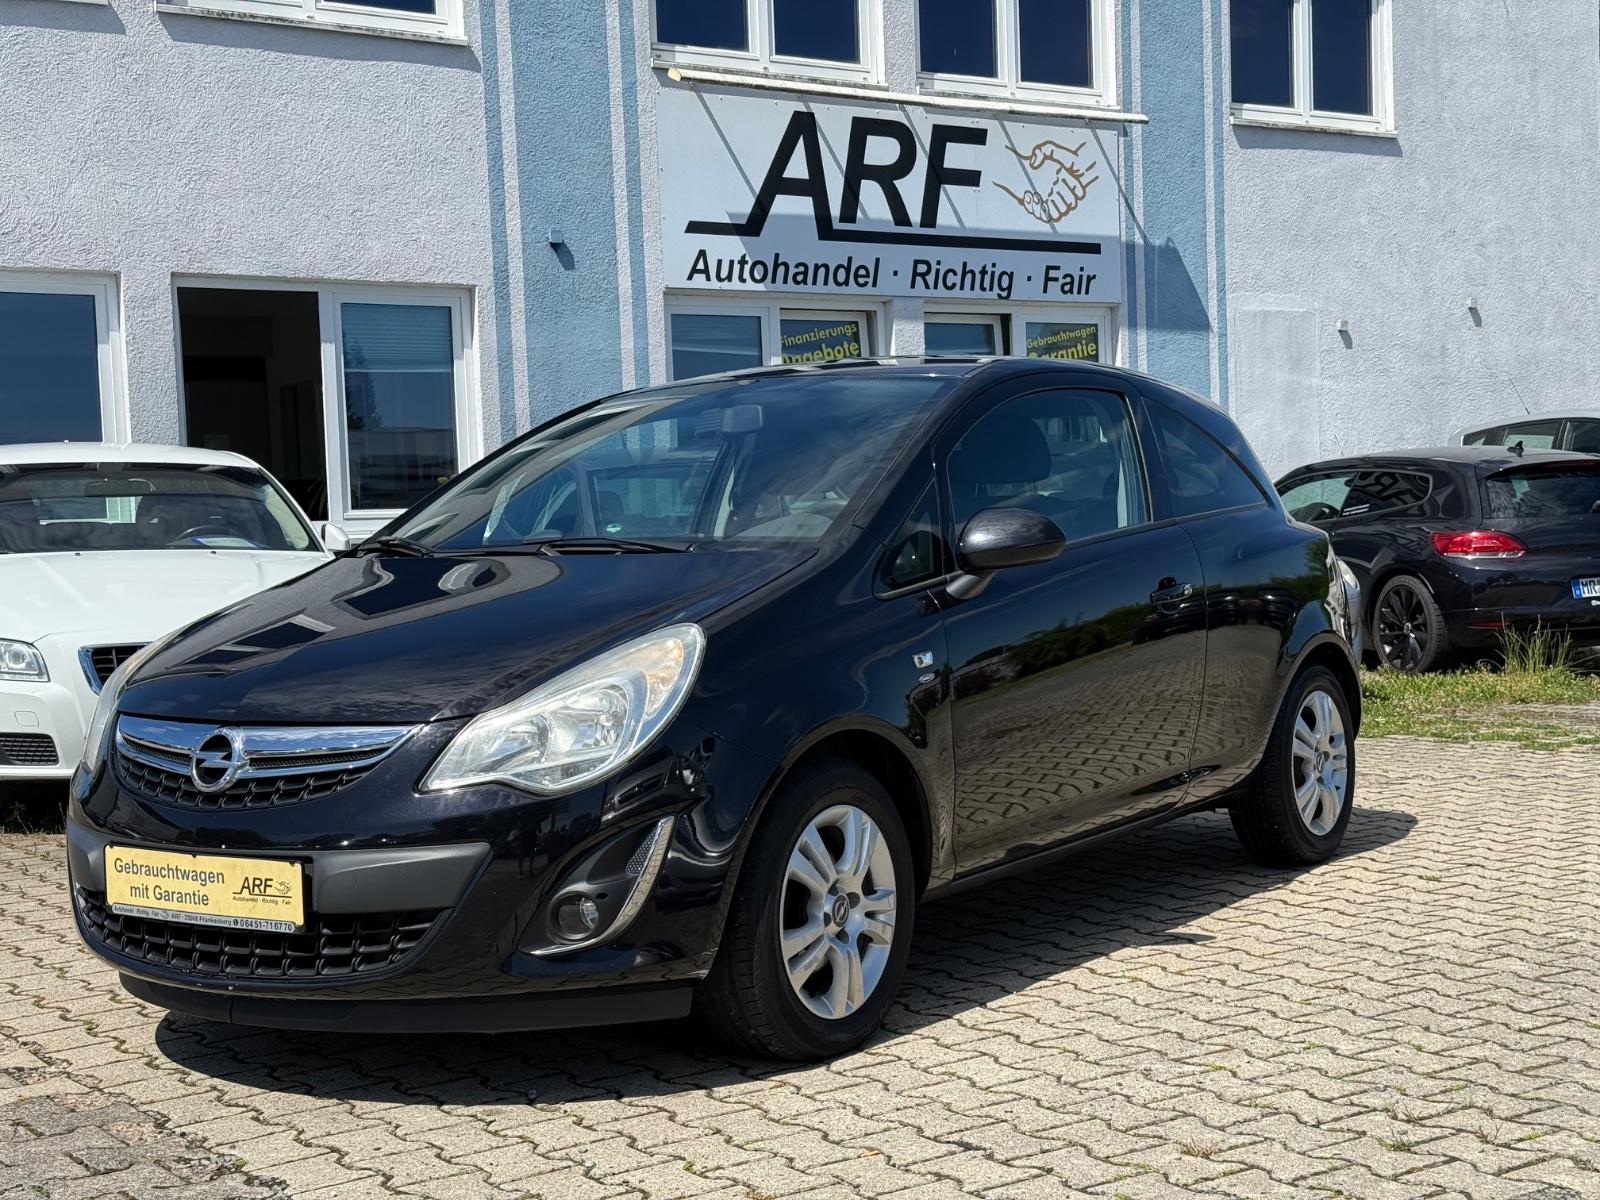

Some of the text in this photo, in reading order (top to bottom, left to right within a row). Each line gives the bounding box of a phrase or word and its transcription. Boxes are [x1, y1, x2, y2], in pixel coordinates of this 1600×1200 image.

[744, 110, 988, 238] ARF
[686, 248, 1098, 301] Autohandel Richtig Fair
[1026, 326, 1096, 349] Gebrauchtwagen
[114, 857, 225, 887] Gebrauchtwagen
[130, 883, 209, 906] mit Garantie
[240, 876, 273, 894] ARF
[199, 916, 232, 926] Frankenberg
